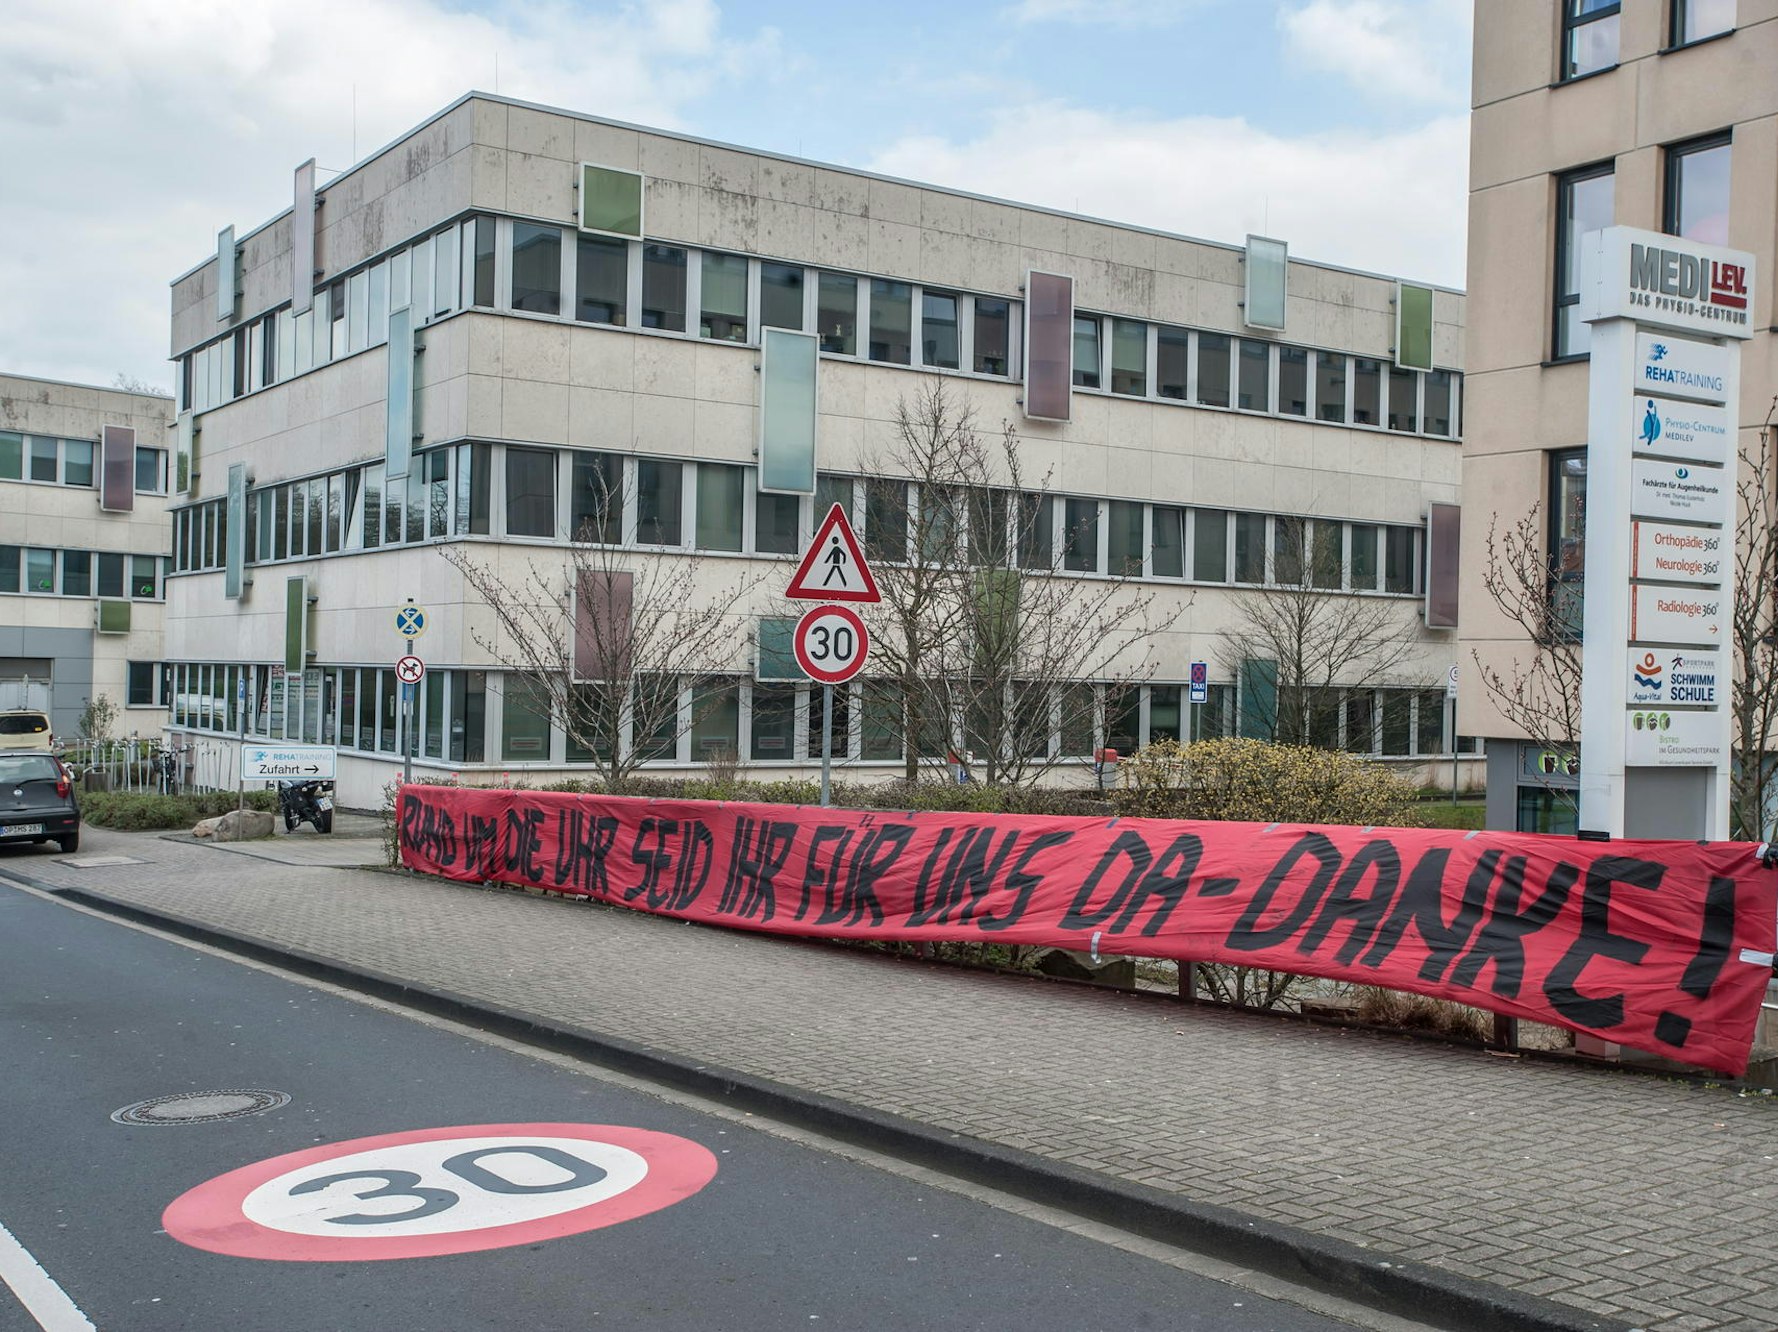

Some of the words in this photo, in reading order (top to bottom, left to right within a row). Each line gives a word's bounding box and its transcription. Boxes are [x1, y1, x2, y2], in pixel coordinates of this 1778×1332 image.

[1629, 291, 1651, 307] DAS
[1655, 296, 1747, 325] PHYSIO-CENTRUM
[1645, 365, 1722, 391] REHATRAINING
[1665, 431, 1694, 442] MEDILEV
[1642, 478, 1668, 489] Fachärzte
[1668, 481, 1676, 490] für
[1677, 483, 1719, 494] Augenheilkunde
[811, 626, 852, 661] 30
[1670, 673, 1715, 686] SCHWIMM
[1670, 686, 1714, 702] SCHULE
[273, 753, 332, 761] REHATRAINING
[259, 764, 300, 774] Zufahrt
[464, 811, 498, 877] UM
[505, 807, 545, 883] DIE
[554, 808, 619, 895] UHR
[624, 818, 714, 911] SEID
[716, 815, 798, 924] IHR
[793, 813, 917, 928] FÜR
[903, 826, 1075, 931] UNS
[288, 1145, 607, 1225] 30
